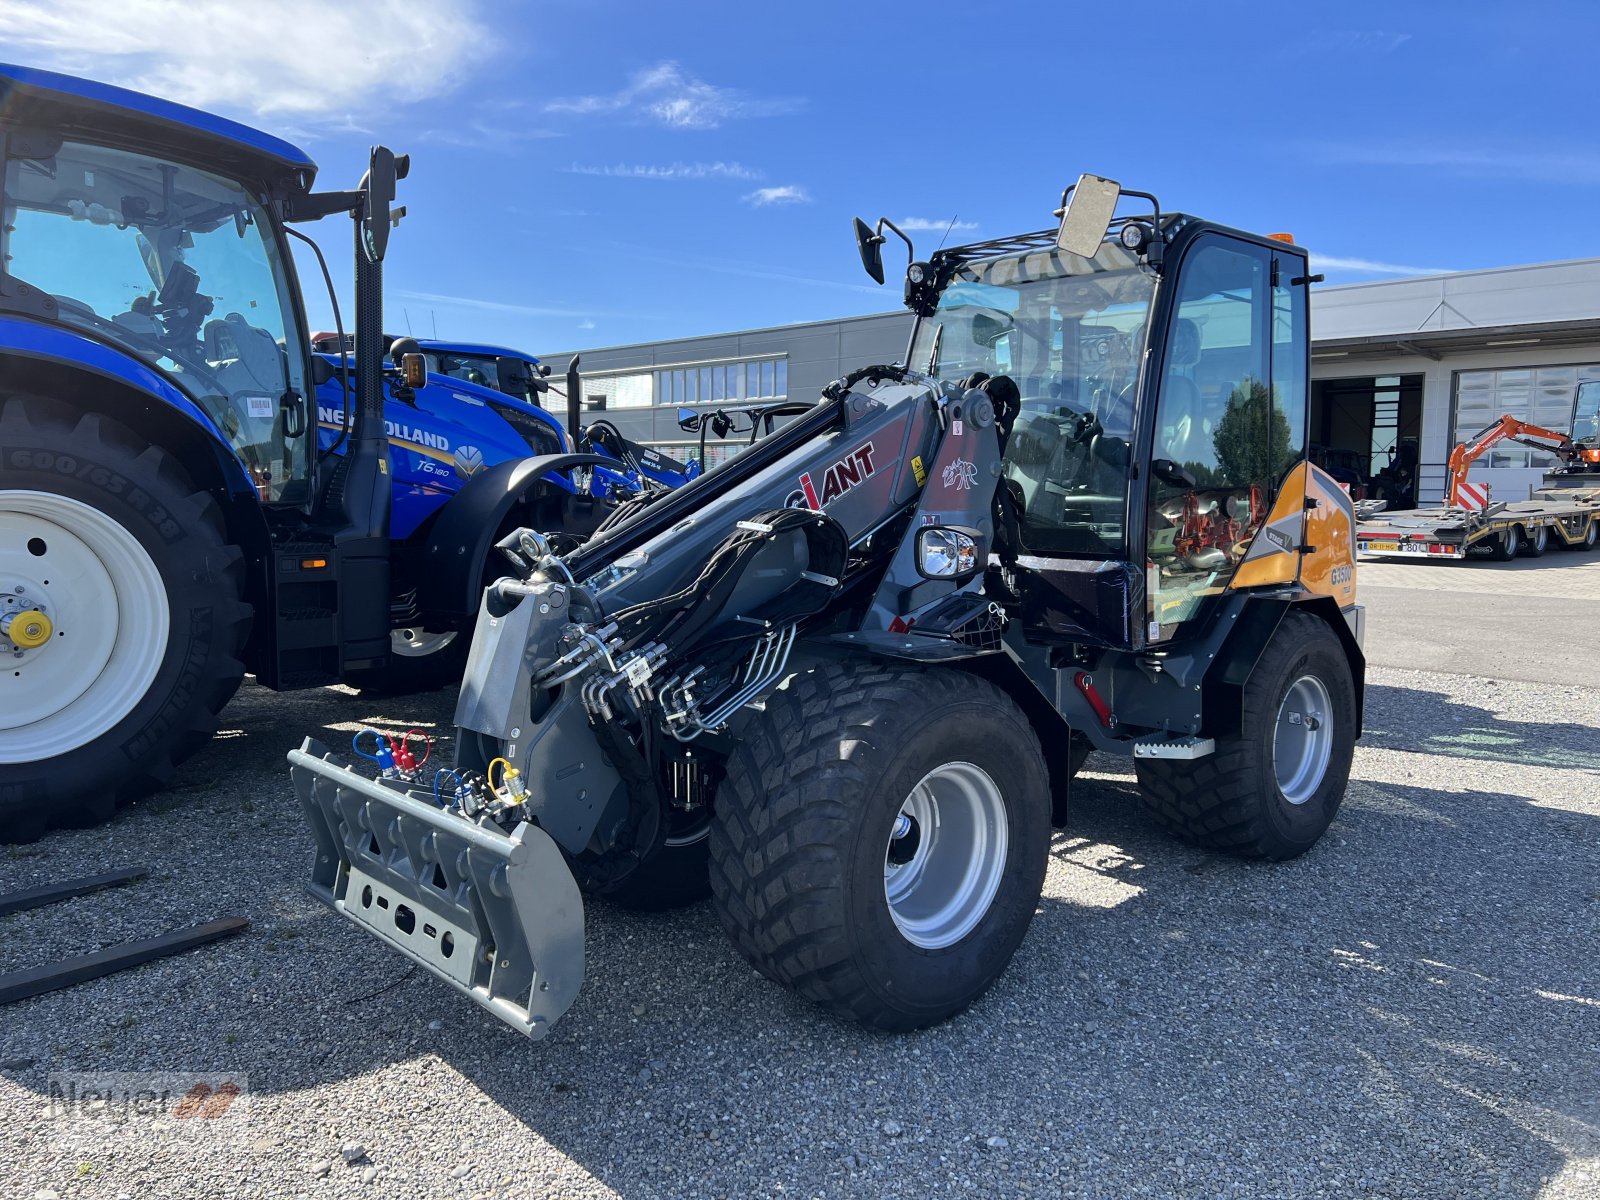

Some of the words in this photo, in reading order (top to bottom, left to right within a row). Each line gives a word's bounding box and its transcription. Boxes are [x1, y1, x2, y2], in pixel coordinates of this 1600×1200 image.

[384, 420, 449, 451] OLLAND
[1484, 431, 1507, 449] HITACHI
[417, 459, 450, 477] T6.180
[10, 450, 127, 495] 600/65
[149, 507, 181, 539] 38
[1268, 532, 1284, 546] STAGE
[1407, 543, 1418, 552] 80
[1331, 565, 1352, 586] G3500
